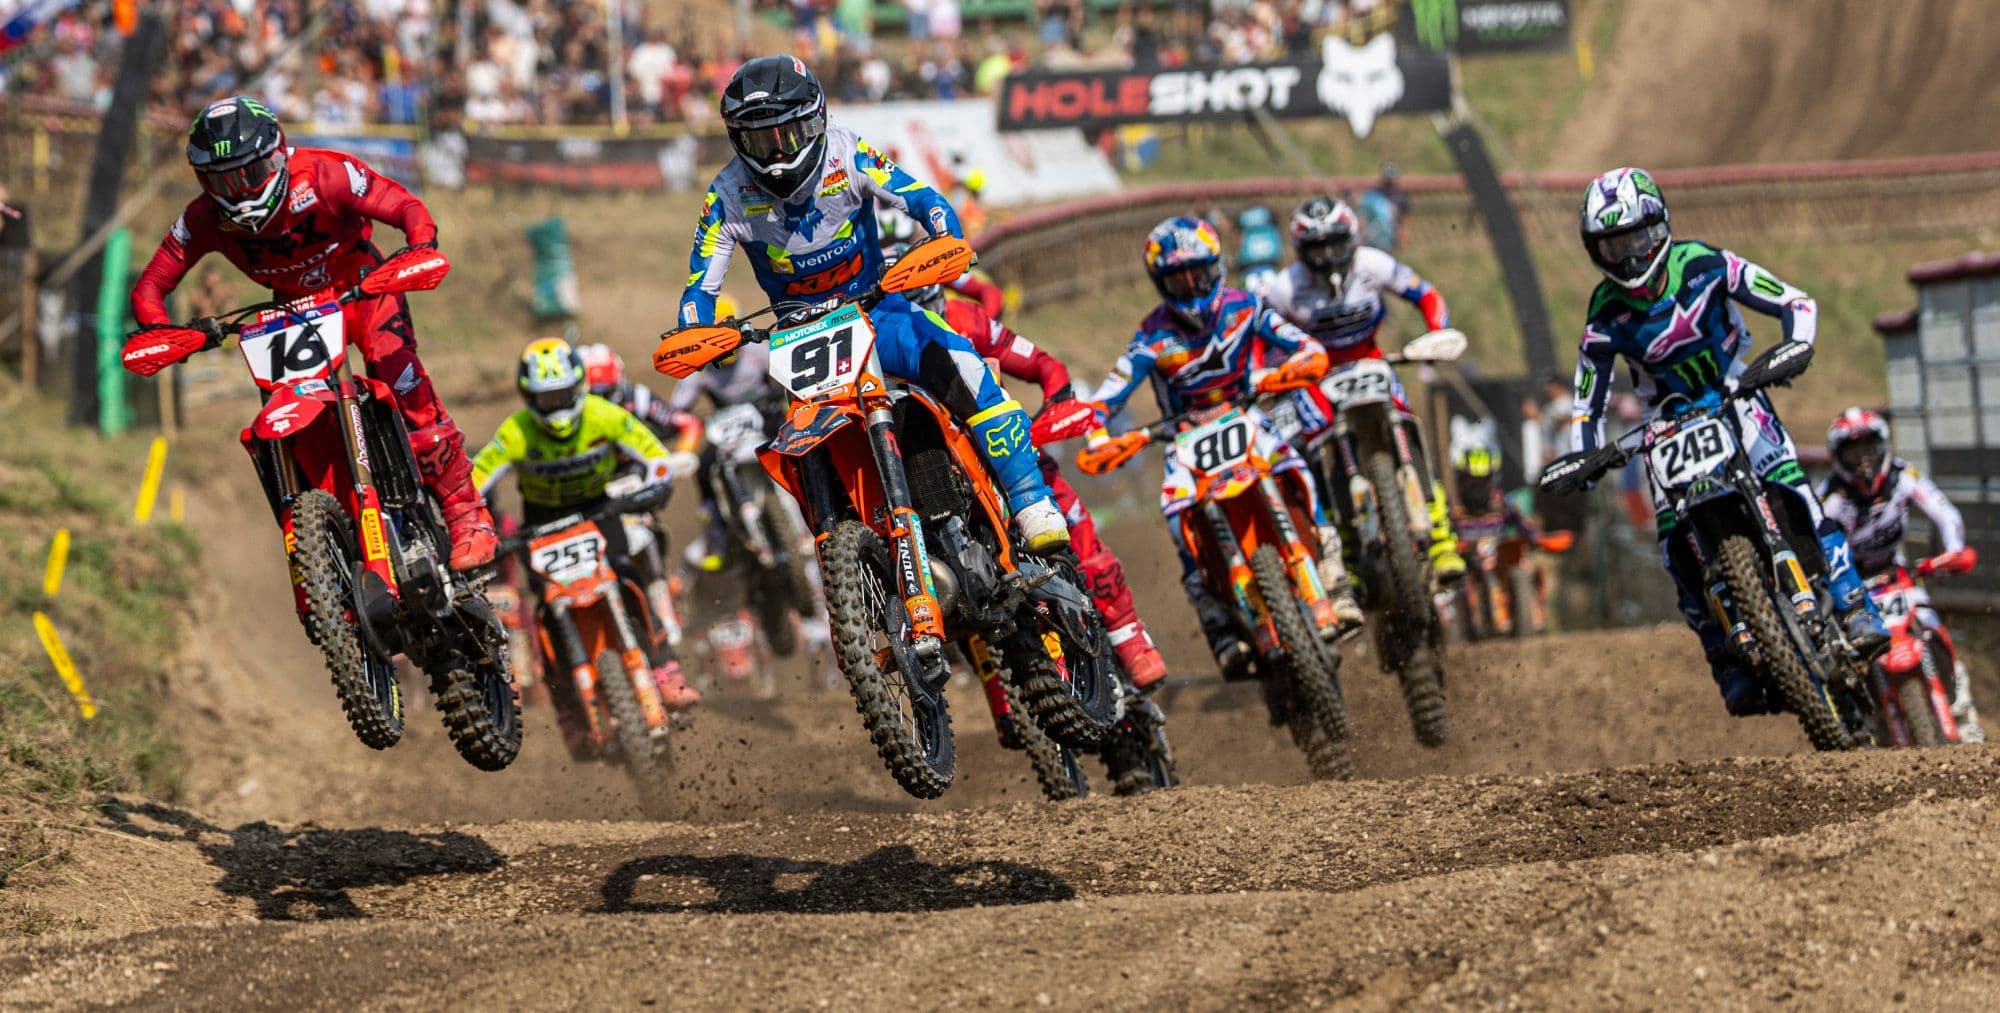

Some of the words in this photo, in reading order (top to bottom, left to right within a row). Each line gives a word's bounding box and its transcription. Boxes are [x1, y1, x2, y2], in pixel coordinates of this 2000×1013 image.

[1010, 66, 1300, 121] HOLESHOT
[796, 232, 857, 269] venrooy
[917, 246, 966, 274] ACERBIS
[784, 252, 863, 297] KTM
[266, 322, 328, 384] 16
[656, 343, 702, 363] ACERBIS
[784, 321, 829, 343] MOTOREX
[791, 326, 853, 392] 91
[1194, 422, 1247, 471] 80
[1661, 424, 1724, 481] 243
[542, 537, 599, 574] 253
[895, 517, 915, 581] DUNLP
